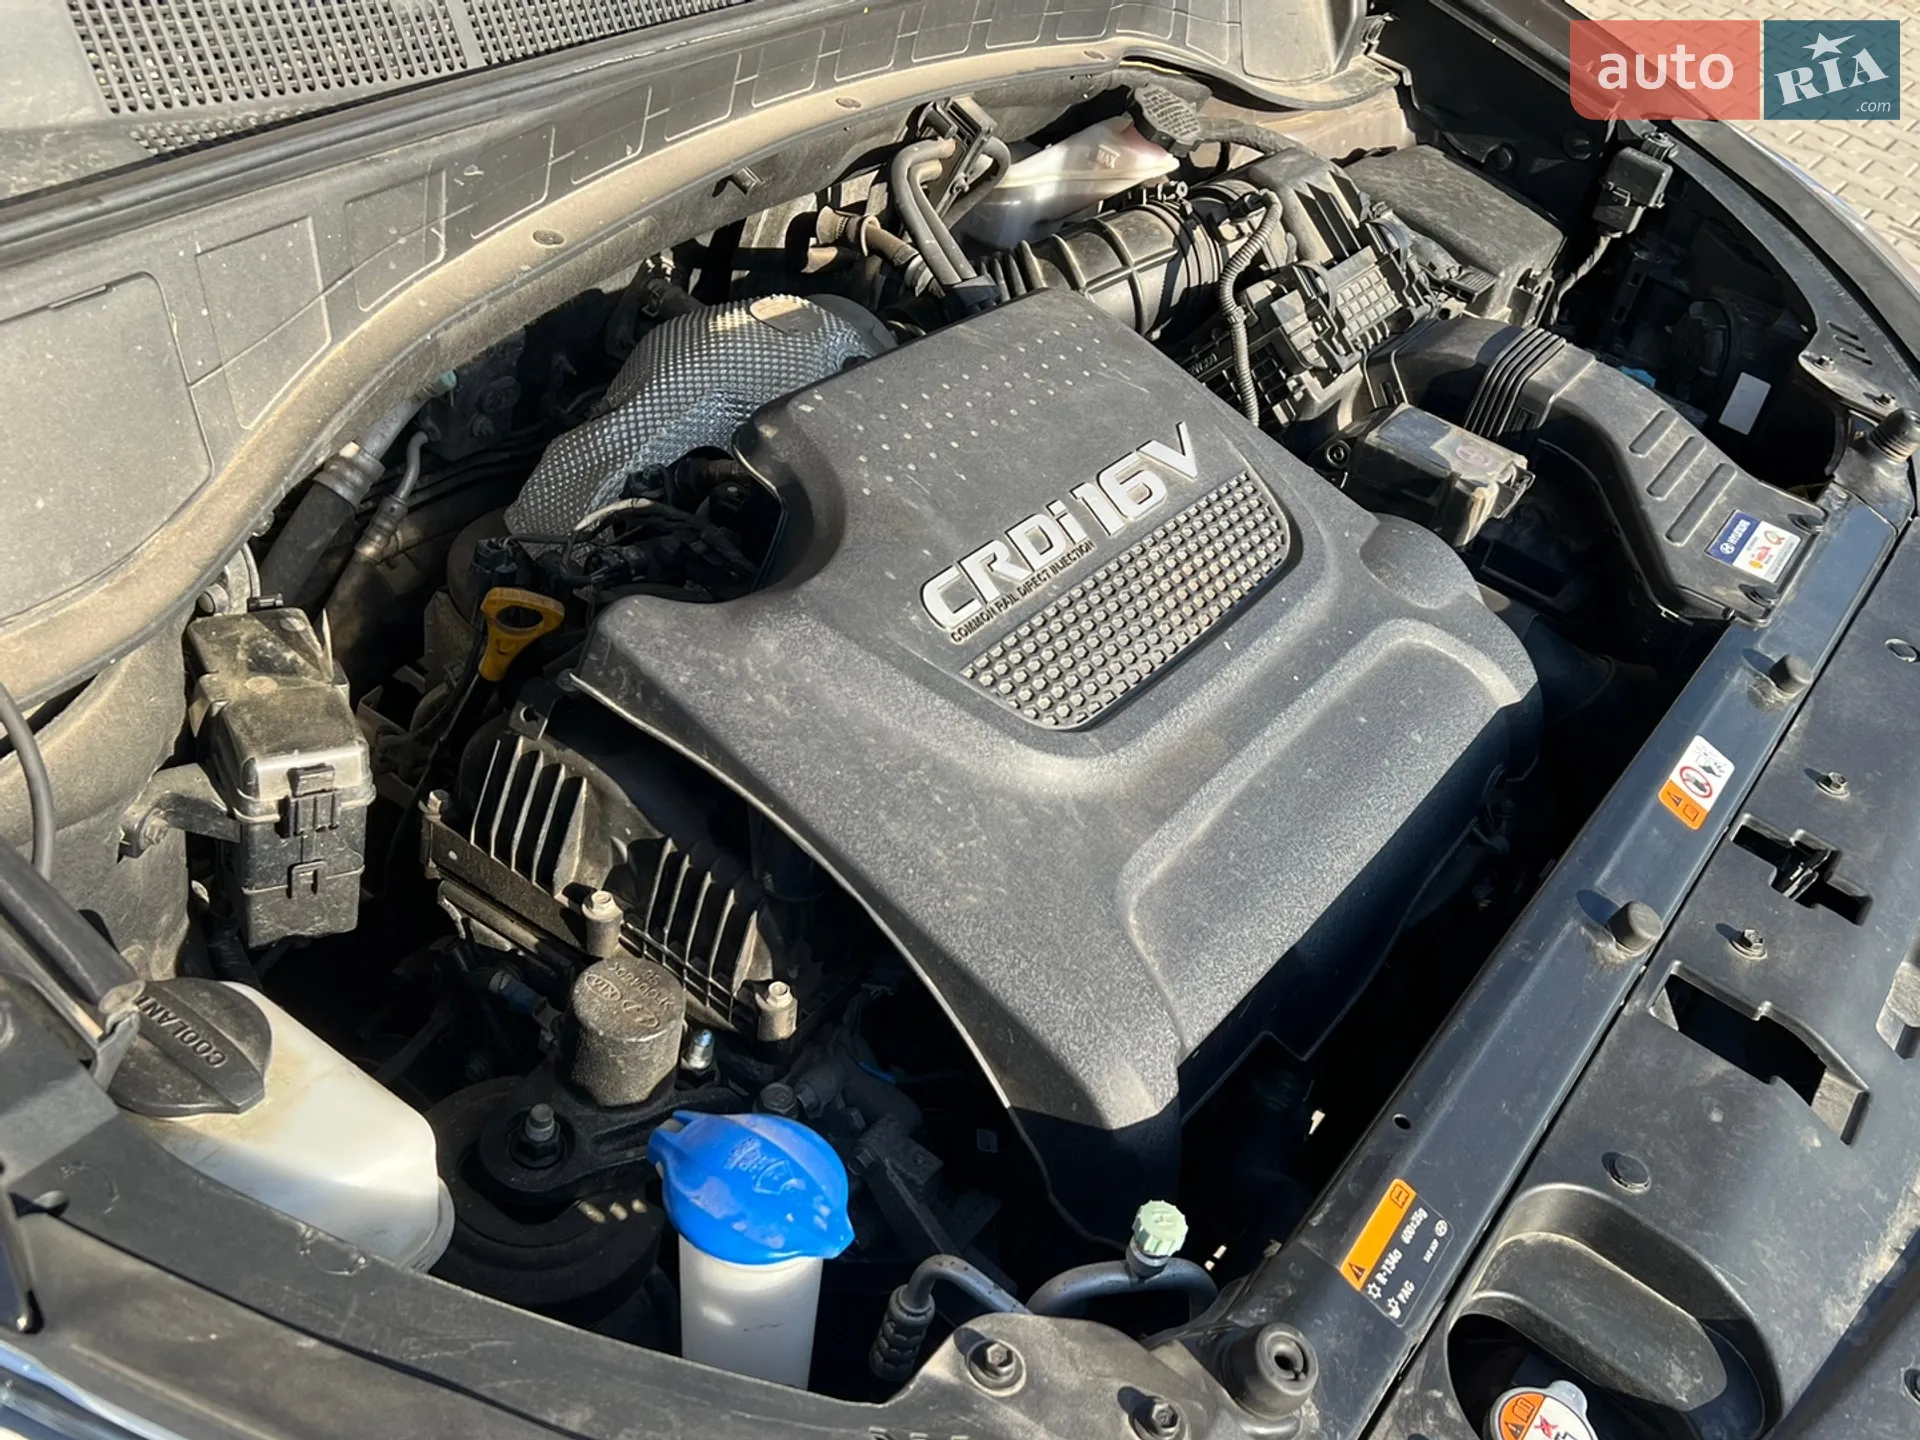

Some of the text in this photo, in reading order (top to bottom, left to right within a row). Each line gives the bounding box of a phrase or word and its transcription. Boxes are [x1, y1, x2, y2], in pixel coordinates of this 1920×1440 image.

[1096, 148, 1117, 169] MAX
[919, 421, 1198, 631] CRDi 16V
[950, 539, 1097, 643] COMMON RAIL DIRECT INJECTION
[589, 977, 617, 999] KIA
[1375, 1248, 1403, 1285] R-134a
[1396, 1280, 1415, 1304] PAG
